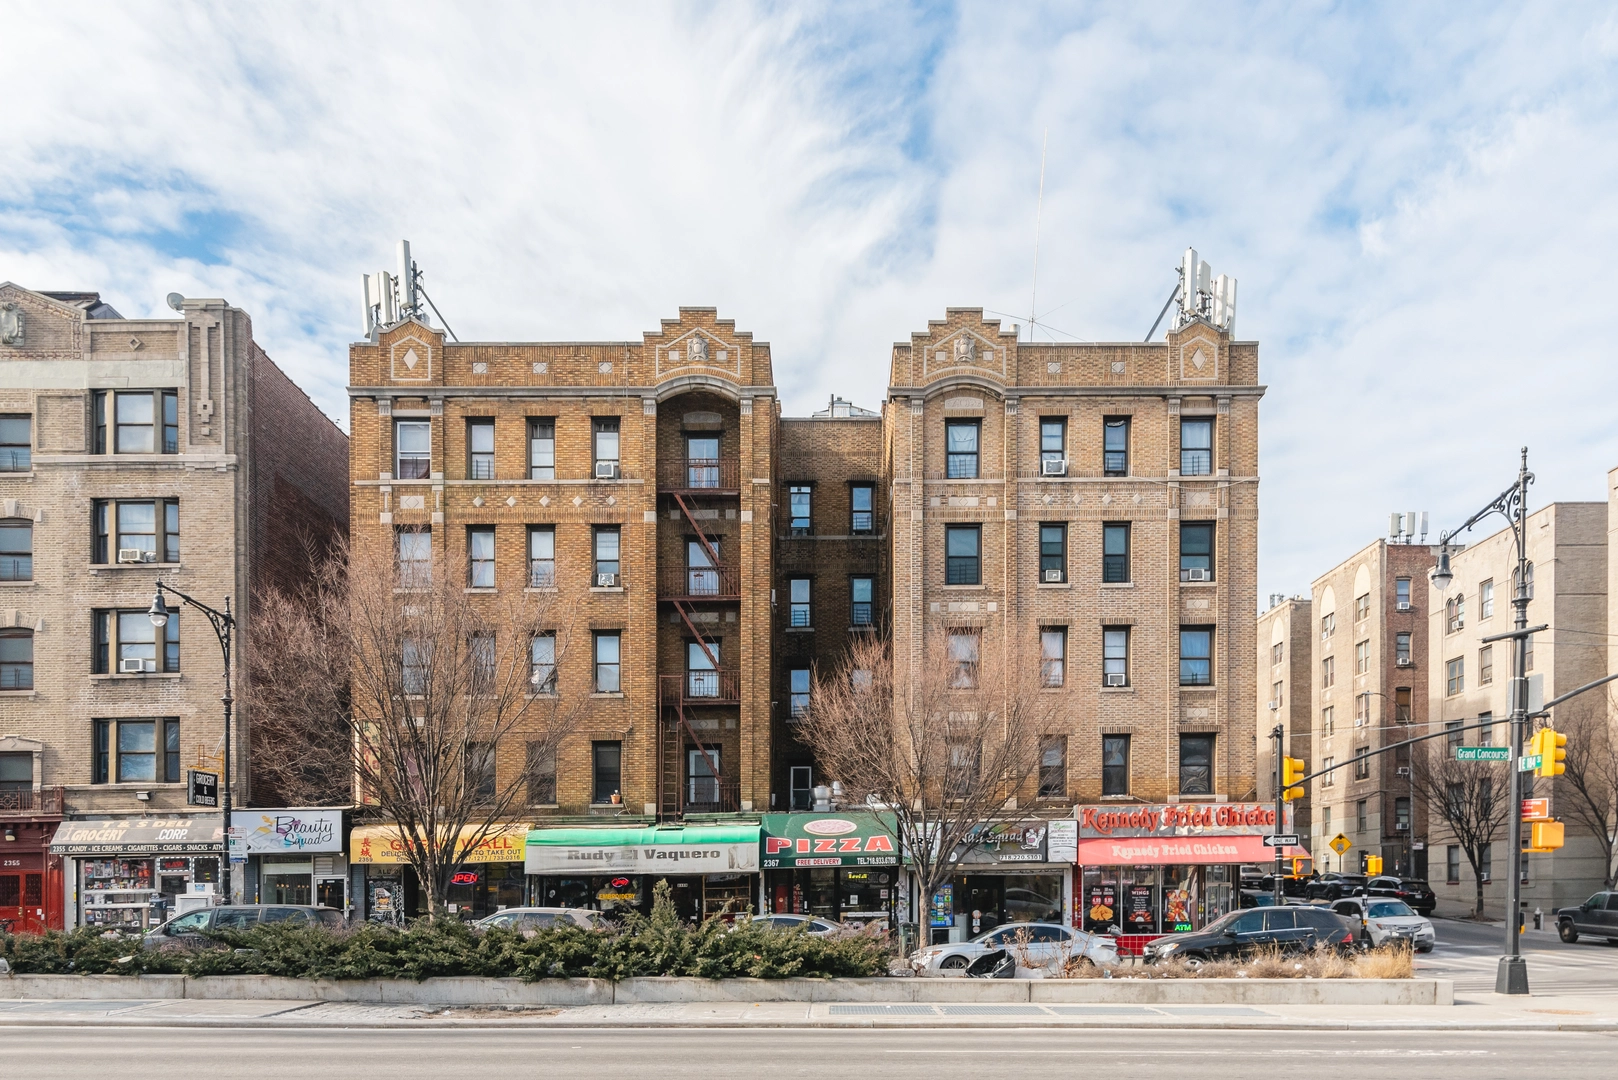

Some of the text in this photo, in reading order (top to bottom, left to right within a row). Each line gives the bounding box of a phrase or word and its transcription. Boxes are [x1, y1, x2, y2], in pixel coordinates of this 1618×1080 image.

[1458, 748, 1508, 759] Grand Concourse
[1522, 758, 1526, 769] E
[195, 773, 216, 786] GROCERY
[195, 794, 205, 804] COLD
[152, 820, 193, 828] DELI
[1082, 807, 1160, 835] Kennedy
[1162, 805, 1213, 827] Fried
[275, 815, 334, 842] Beauty
[71, 829, 127, 841] GROCERY
[284, 832, 322, 850] Squad
[986, 828, 1024, 852] Squad
[127, 844, 159, 852] CIGARETTES
[461, 837, 513, 849] WALL
[766, 835, 894, 855] PIZZA
[567, 848, 721, 862] Rudy El Vaquero
[1111, 844, 1239, 860] Kennedy Fried Chicken
[763, 859, 780, 867] 2367
[813, 858, 840, 866] DELIVERY
[451, 874, 478, 883] OPEN
[1174, 923, 1192, 932] ATM
